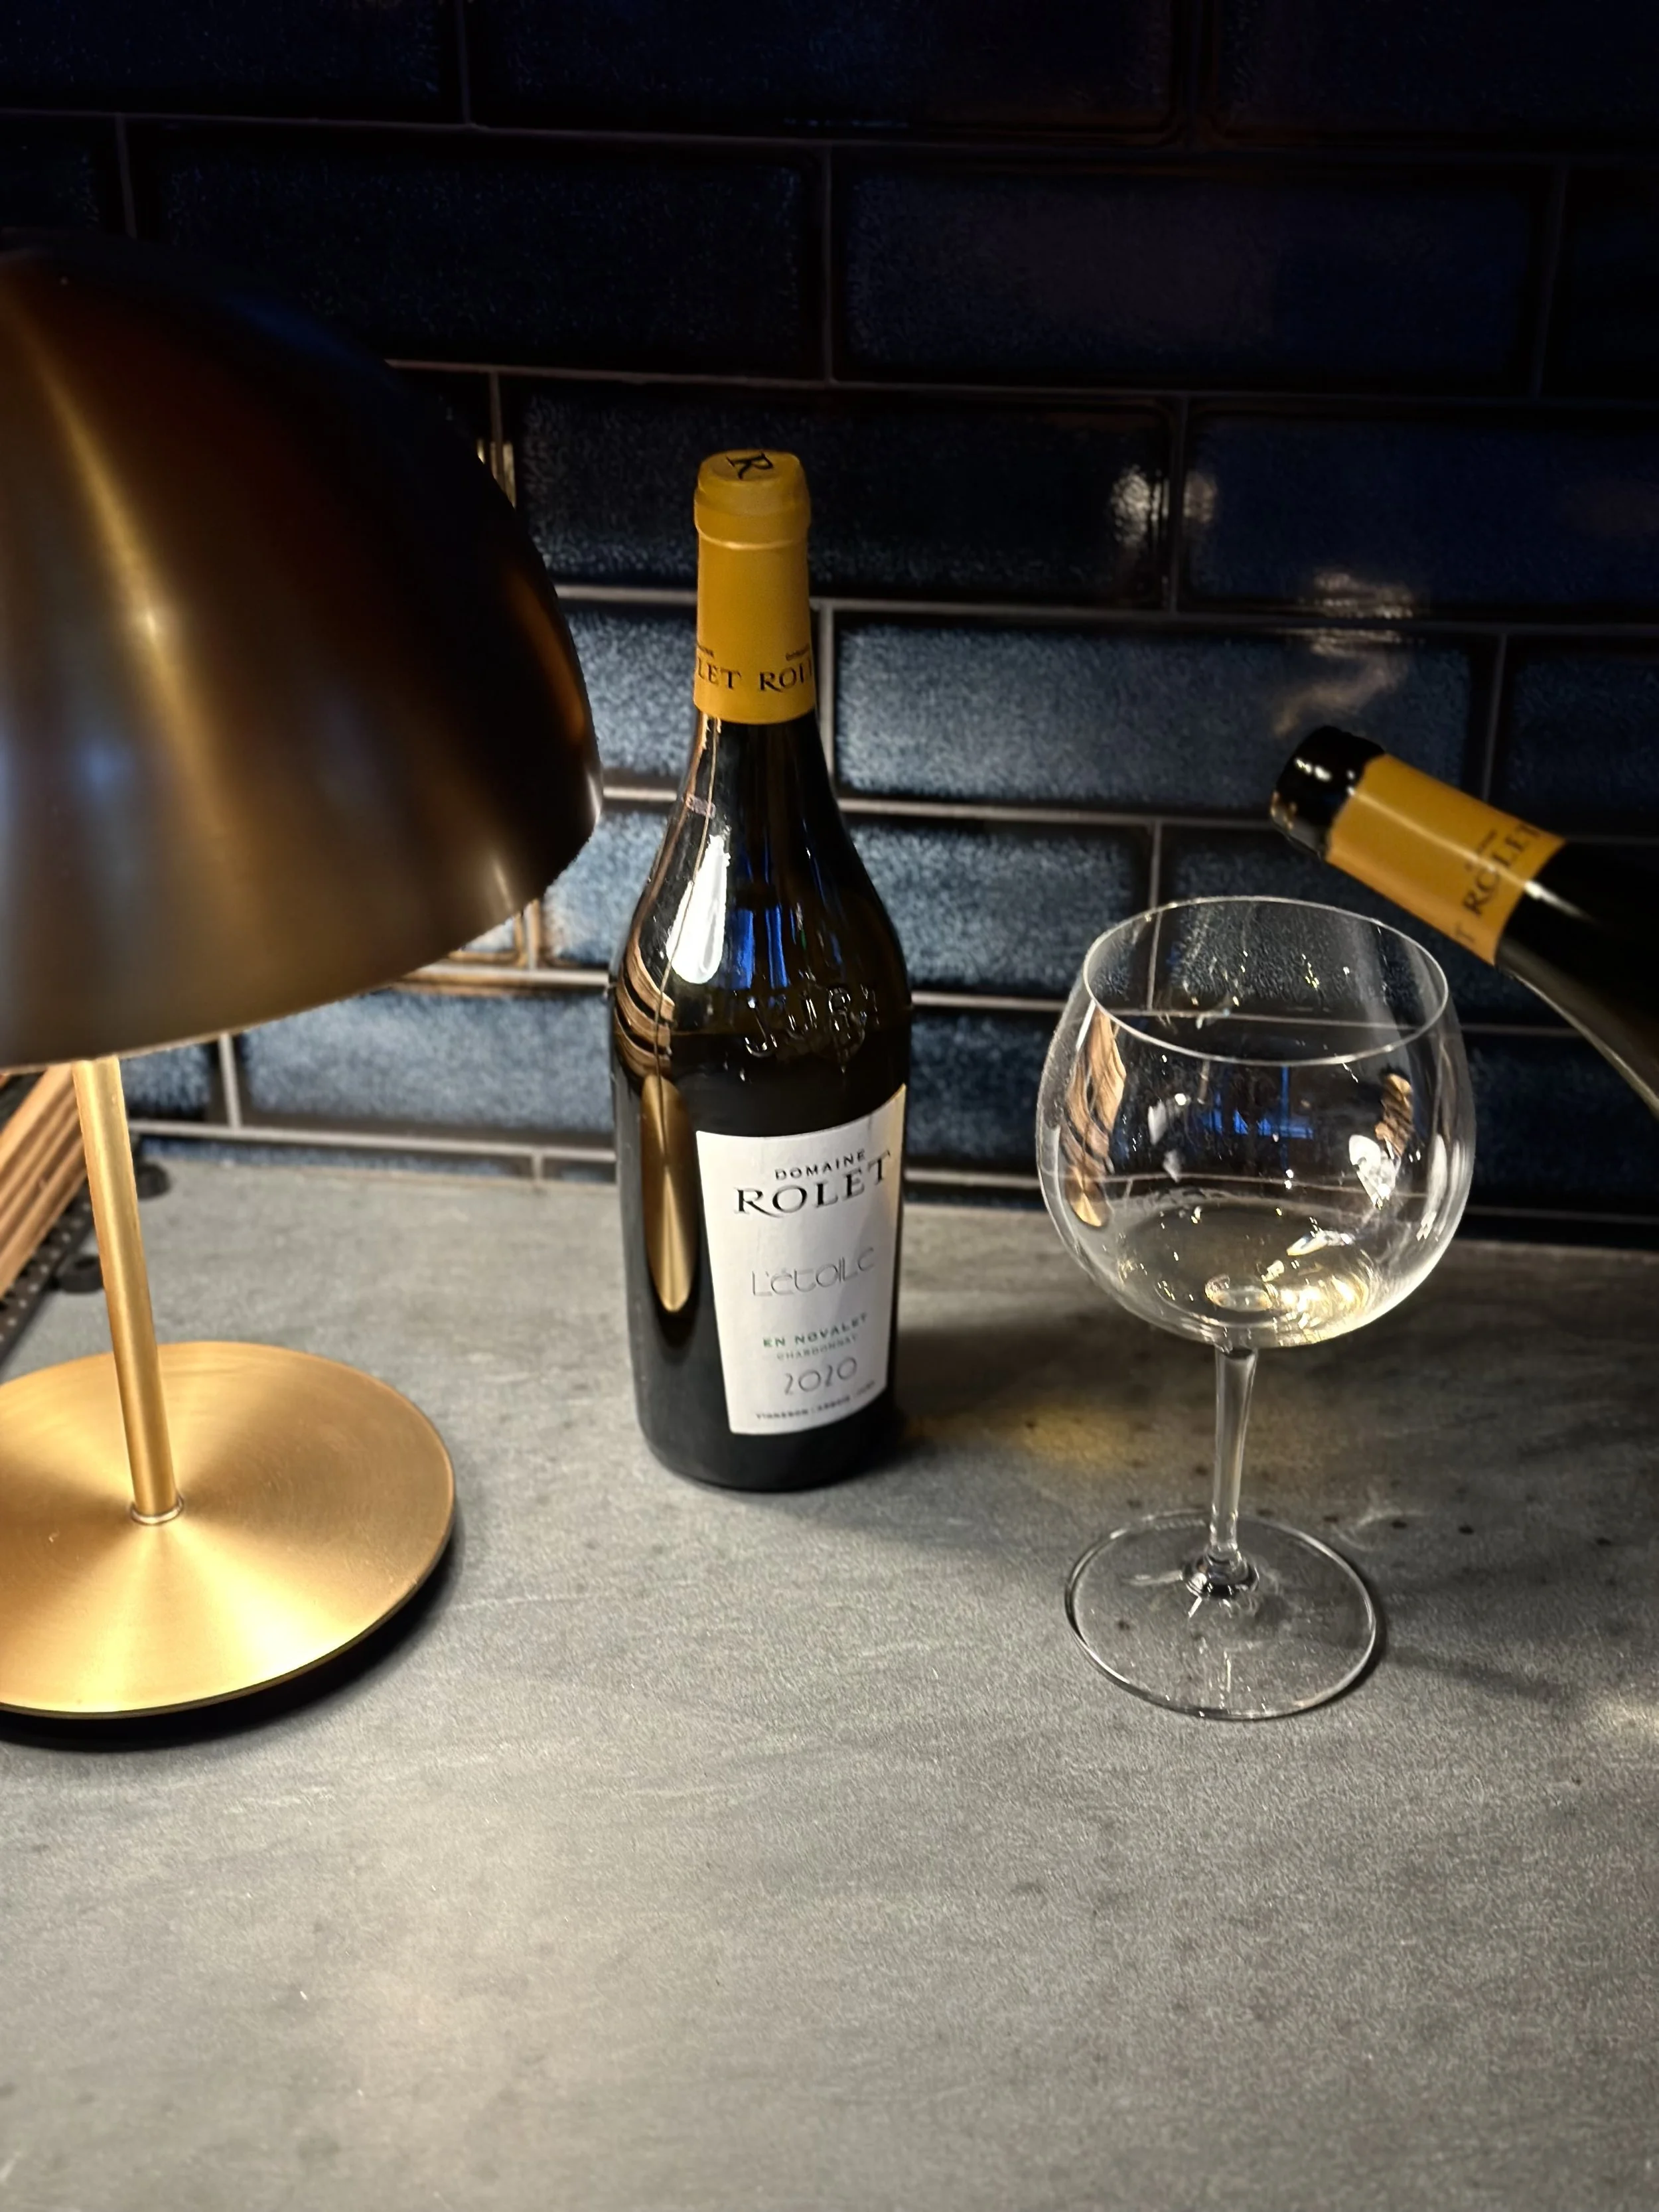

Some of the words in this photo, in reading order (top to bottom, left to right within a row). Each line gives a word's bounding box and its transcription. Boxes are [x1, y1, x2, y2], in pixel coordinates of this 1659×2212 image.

[727, 452, 774, 480] R
[774, 1149, 866, 1181] DOMAINE
[734, 1150, 891, 1218] ROLET
[762, 1337, 786, 1348] EN
[784, 1357, 857, 1396] 2020
